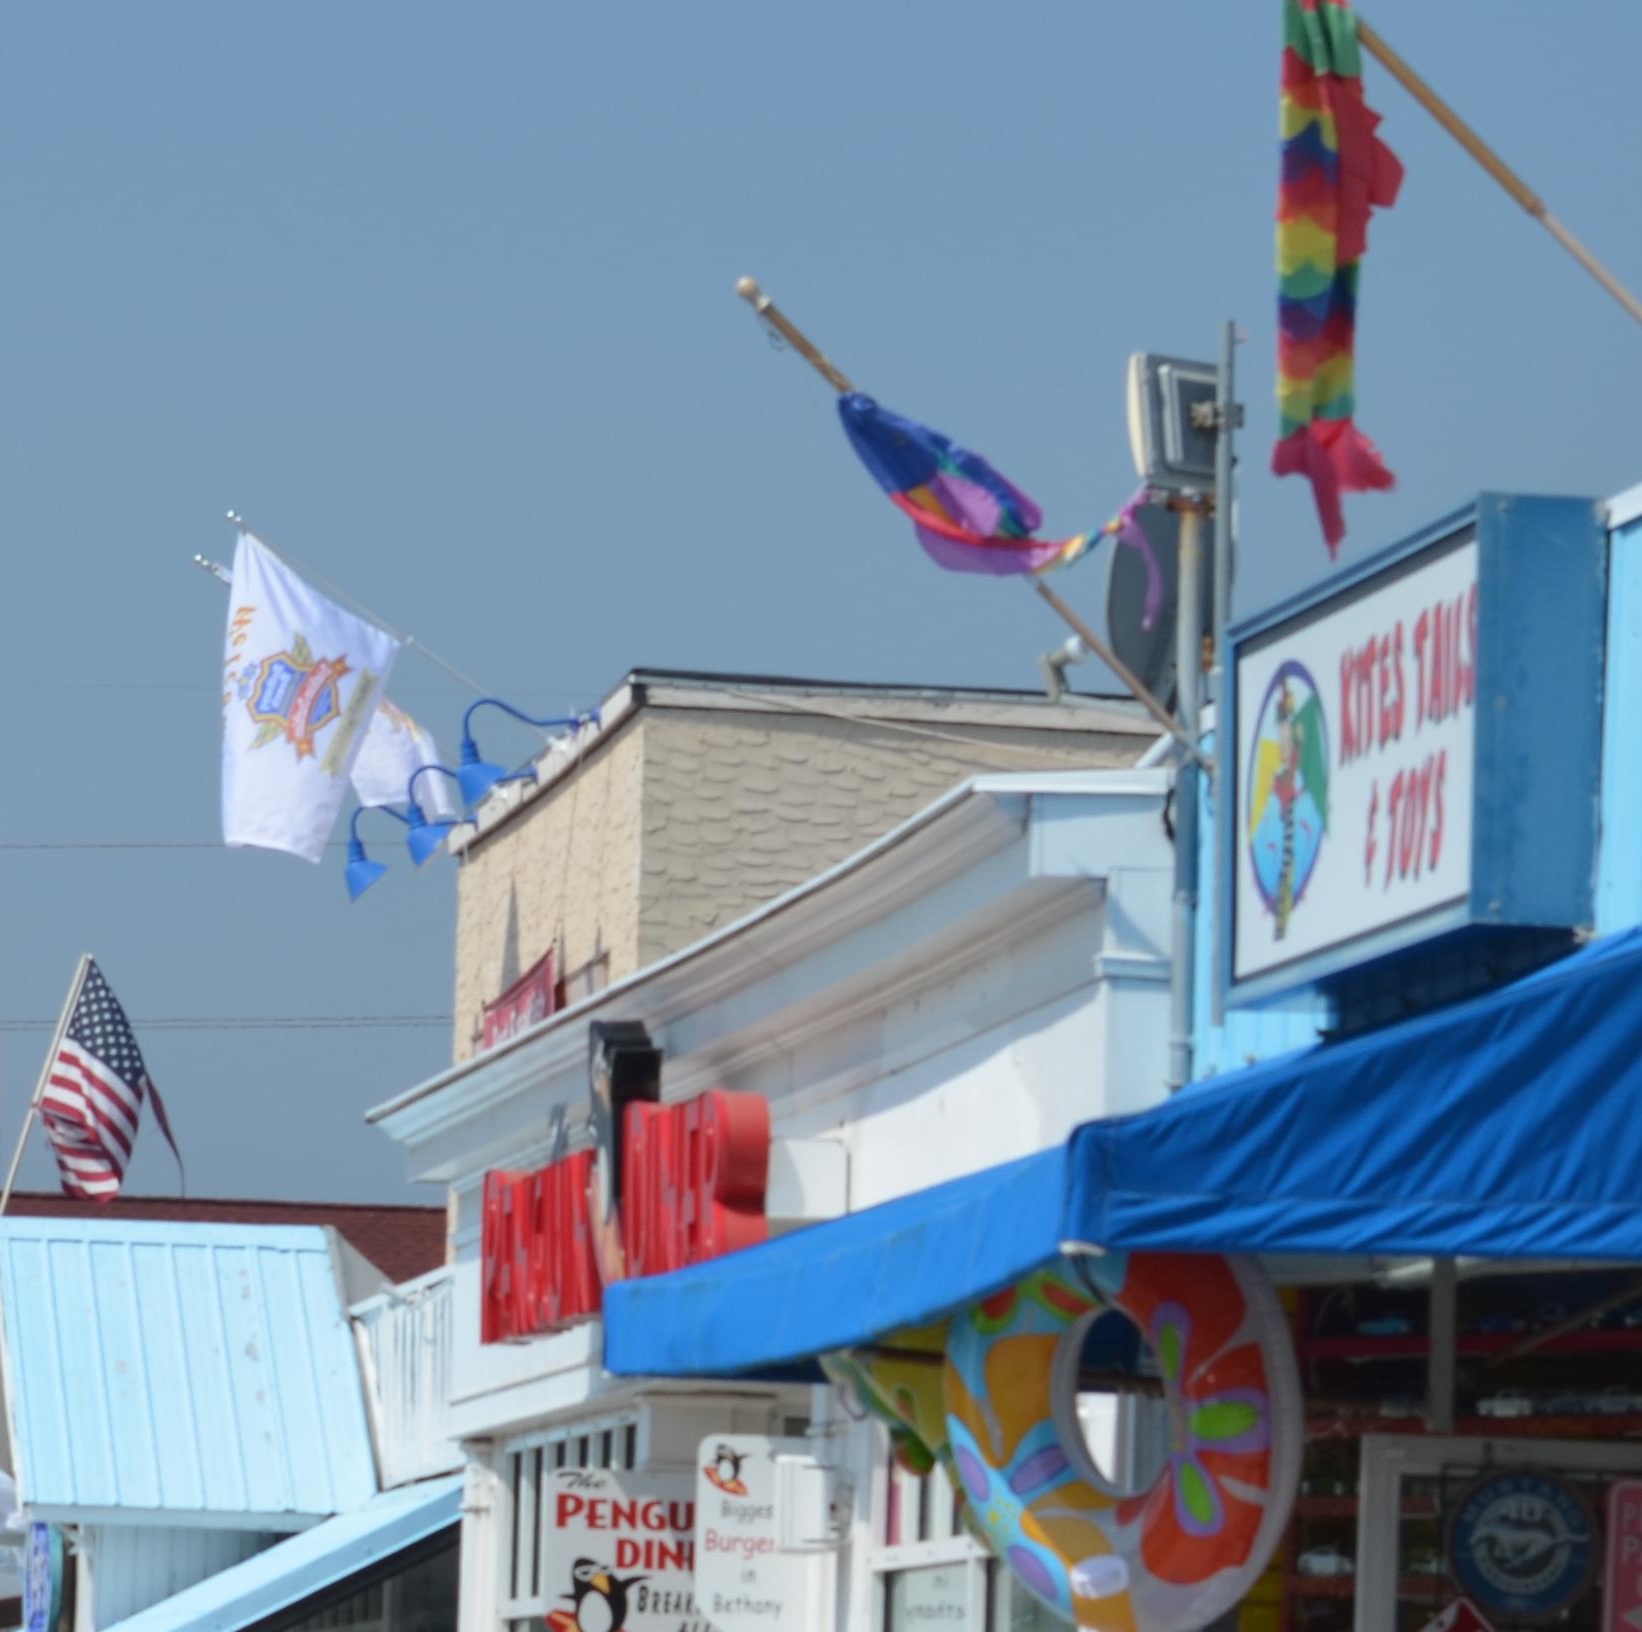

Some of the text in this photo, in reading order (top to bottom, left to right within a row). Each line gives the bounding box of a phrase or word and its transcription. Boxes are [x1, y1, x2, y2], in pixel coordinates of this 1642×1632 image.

[1340, 620, 1404, 769] KITES
[1385, 750, 1447, 891] TOYS
[558, 1470, 606, 1489] The
[555, 1492, 694, 1532] PENGU
[714, 1592, 783, 1621] Bethany
